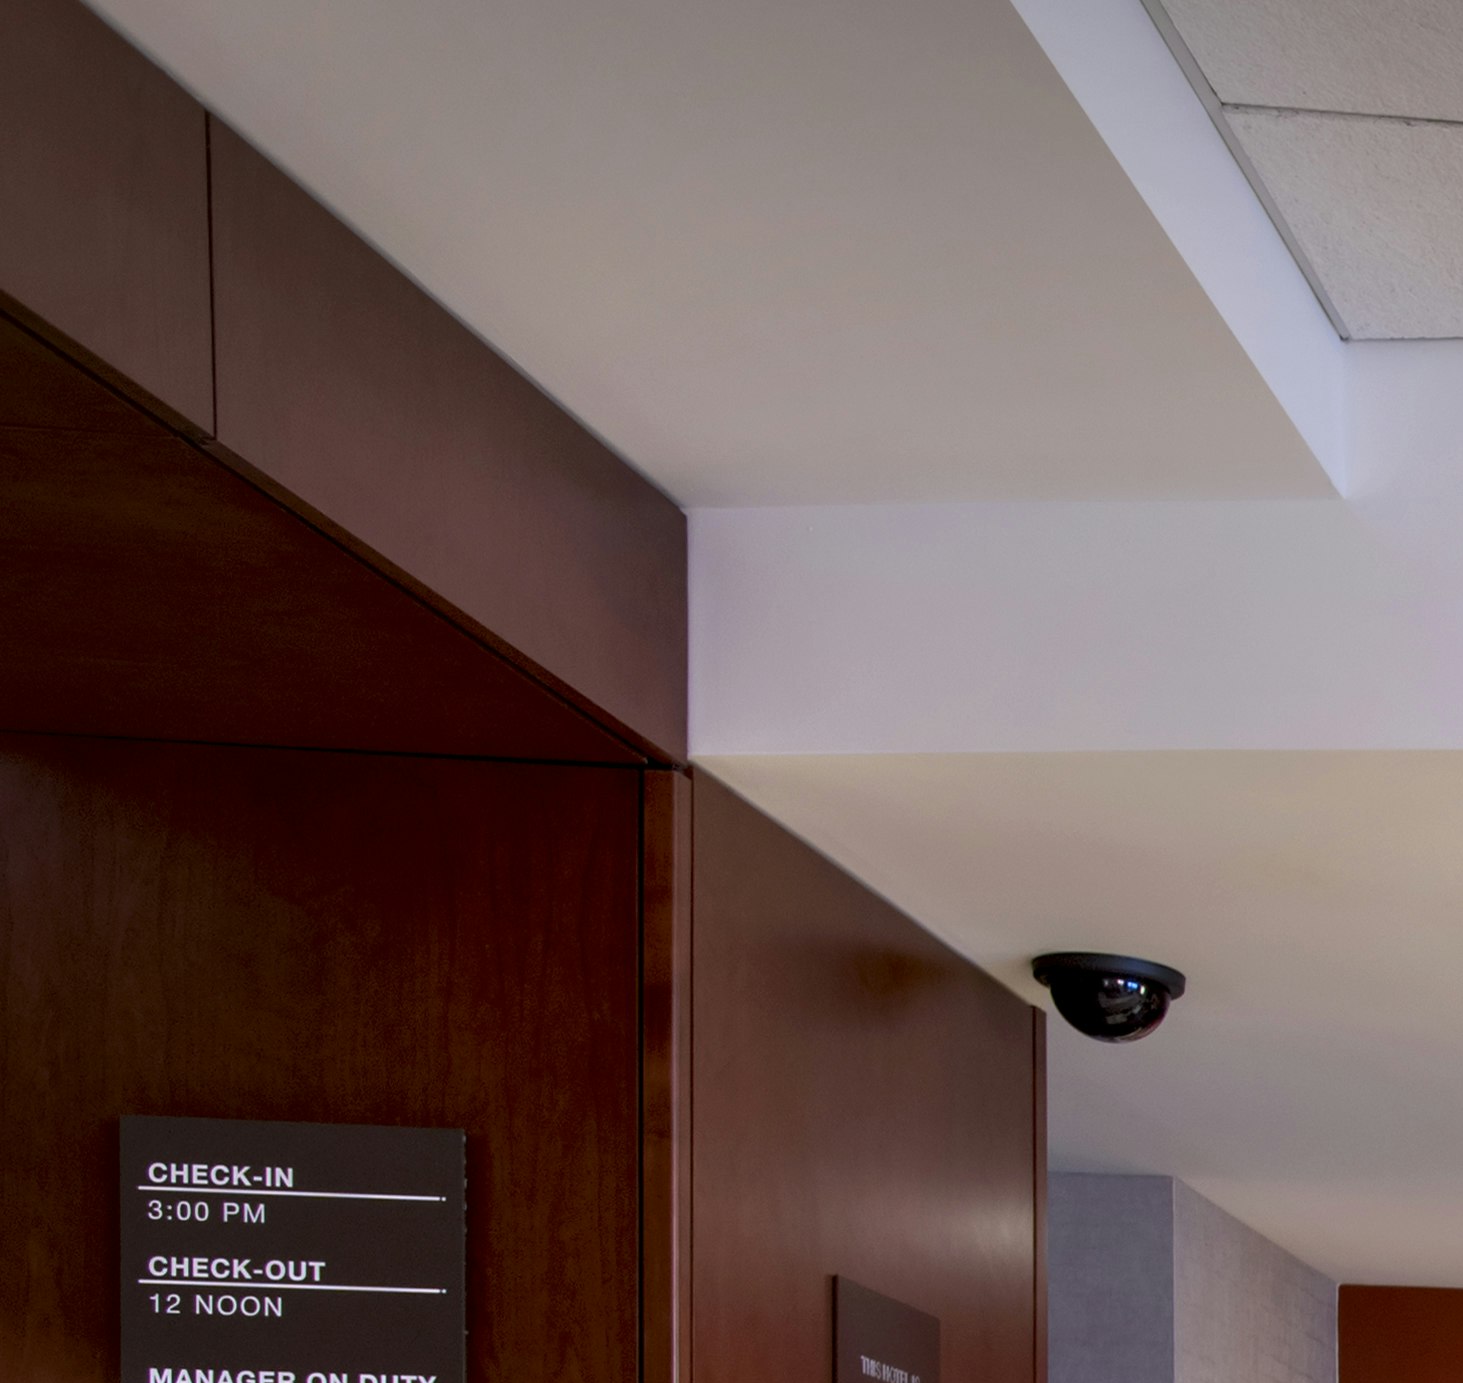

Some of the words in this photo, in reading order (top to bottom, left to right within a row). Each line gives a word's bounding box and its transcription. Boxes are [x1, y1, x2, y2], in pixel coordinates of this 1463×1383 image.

[148, 1162, 294, 1188] CHECK-IN
[148, 1200, 210, 1222] 3:00
[223, 1202, 266, 1223] PM
[148, 1256, 326, 1281] CHECK-OUT
[149, 1294, 181, 1314] 12
[195, 1295, 283, 1317] NOON
[861, 1355, 881, 1380] THIS
